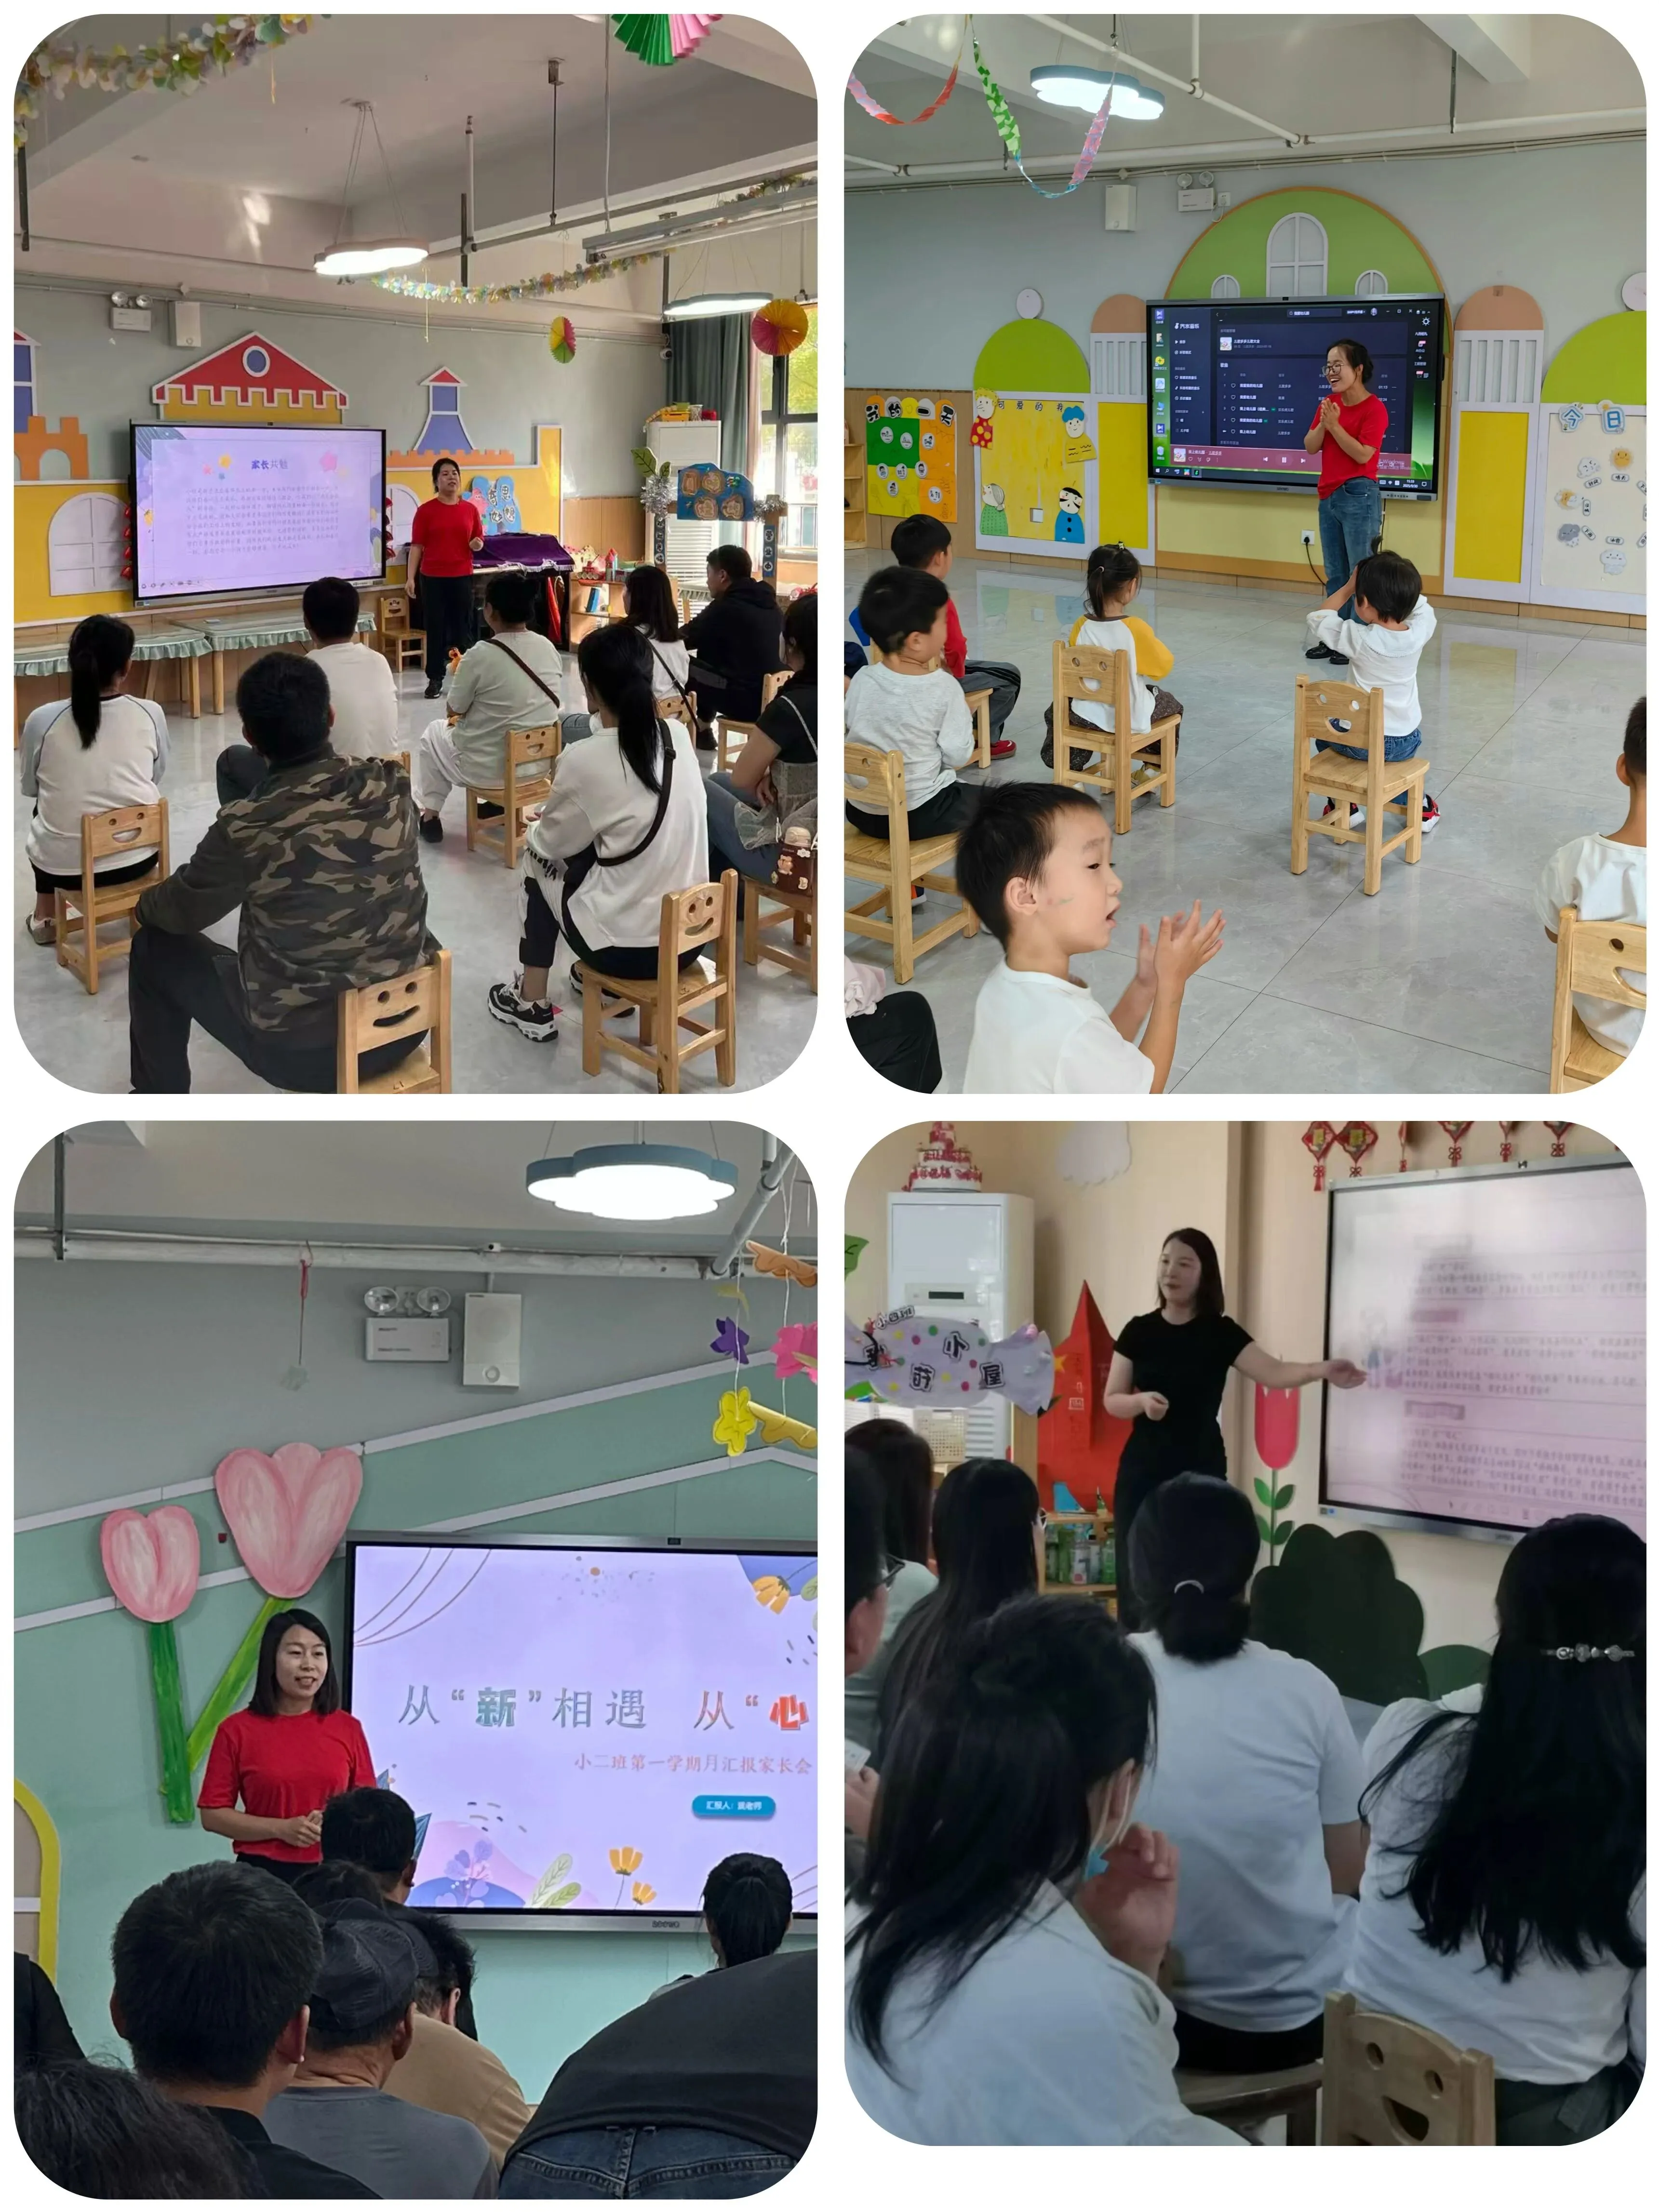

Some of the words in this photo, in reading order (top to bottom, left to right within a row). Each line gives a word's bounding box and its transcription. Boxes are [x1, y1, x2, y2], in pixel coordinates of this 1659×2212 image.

[999, 400, 1064, 412] 可爱的我
[1564, 409, 1621, 428] 今日
[251, 459, 288, 470] 家长共勉
[574, 1753, 812, 1774] 小二班第一学期月汇报家长会
